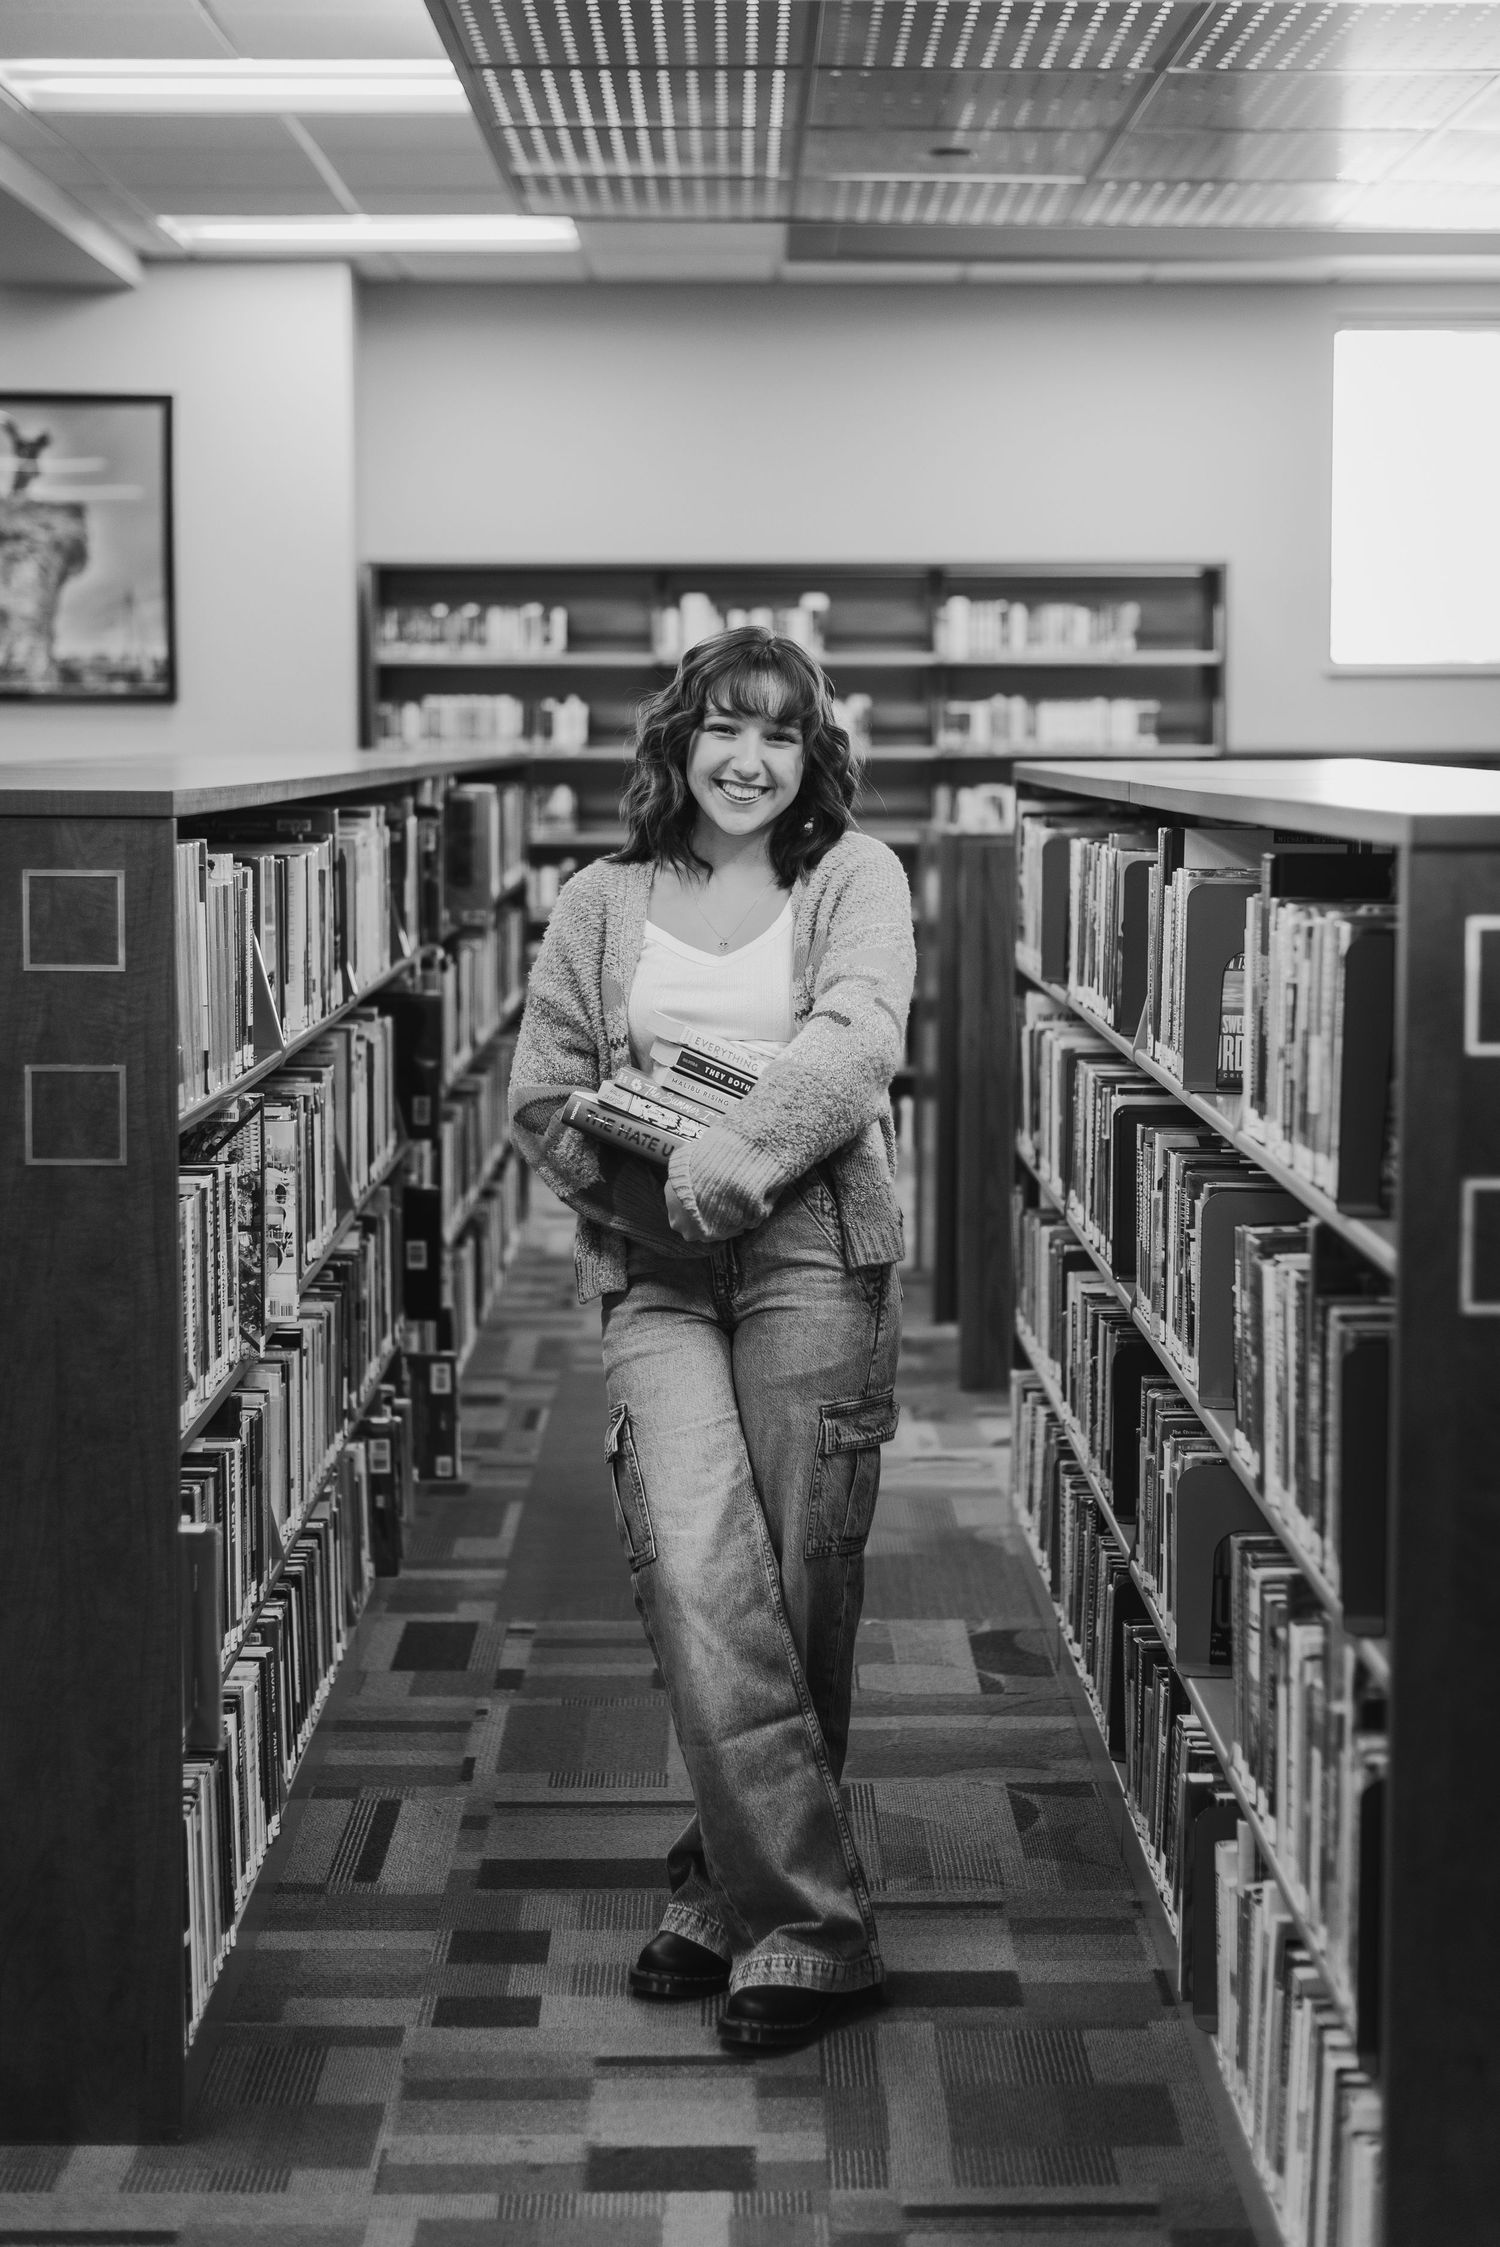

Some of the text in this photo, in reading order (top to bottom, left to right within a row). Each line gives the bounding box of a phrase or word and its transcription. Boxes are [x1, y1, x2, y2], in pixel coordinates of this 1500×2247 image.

[695, 1036, 759, 1072] EVERYTHING
[671, 1077, 729, 1106] MALIBU RISING
[704, 1066, 751, 1092] THEY BOTH
[644, 1083, 661, 1099] The
[660, 1092, 701, 1117] Summer
[585, 1108, 616, 1133] THE
[617, 1124, 660, 1152] HATE
[662, 1143, 675, 1158] U
